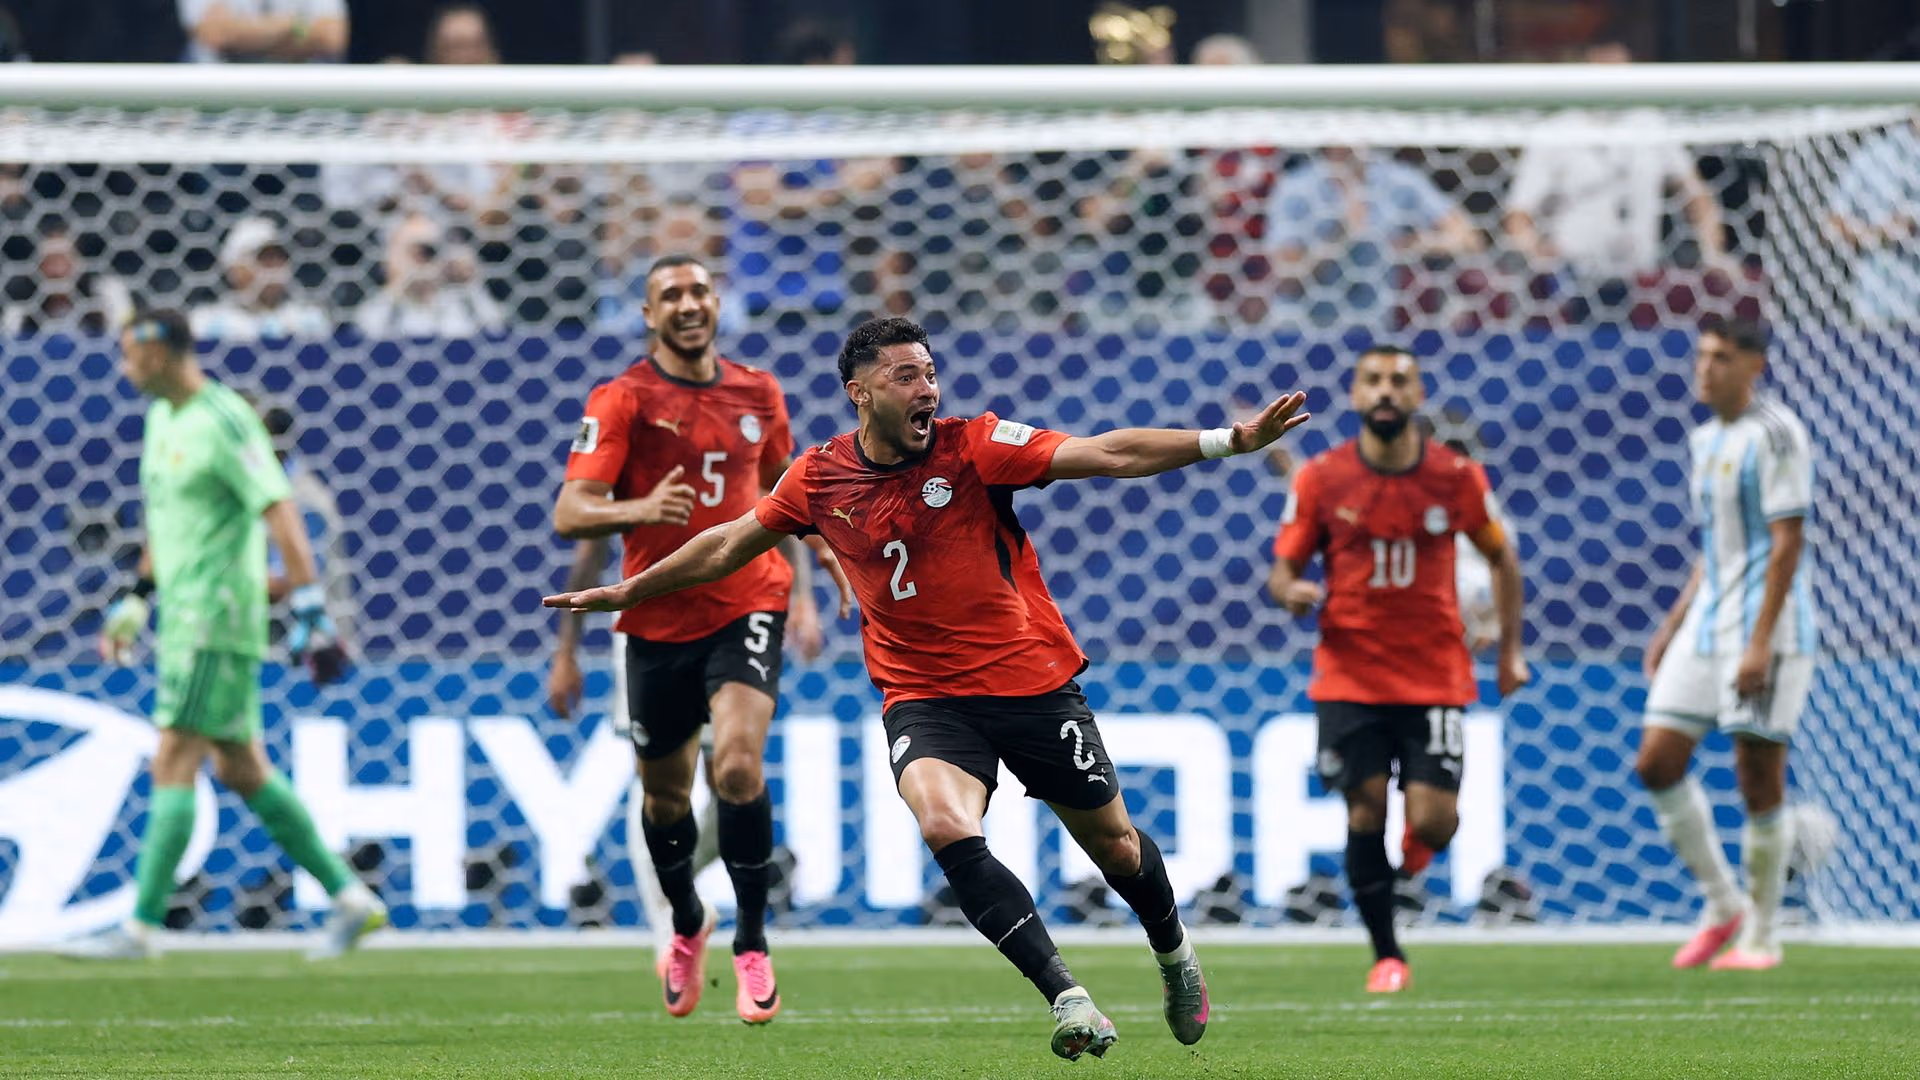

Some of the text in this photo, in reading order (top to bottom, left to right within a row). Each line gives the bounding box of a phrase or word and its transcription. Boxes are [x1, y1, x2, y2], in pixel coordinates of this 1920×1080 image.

[700, 451, 727, 507] 5
[882, 539, 917, 601] 2
[1368, 537, 1416, 589] 10
[743, 611, 774, 654] 5
[1060, 720, 1096, 771] 2
